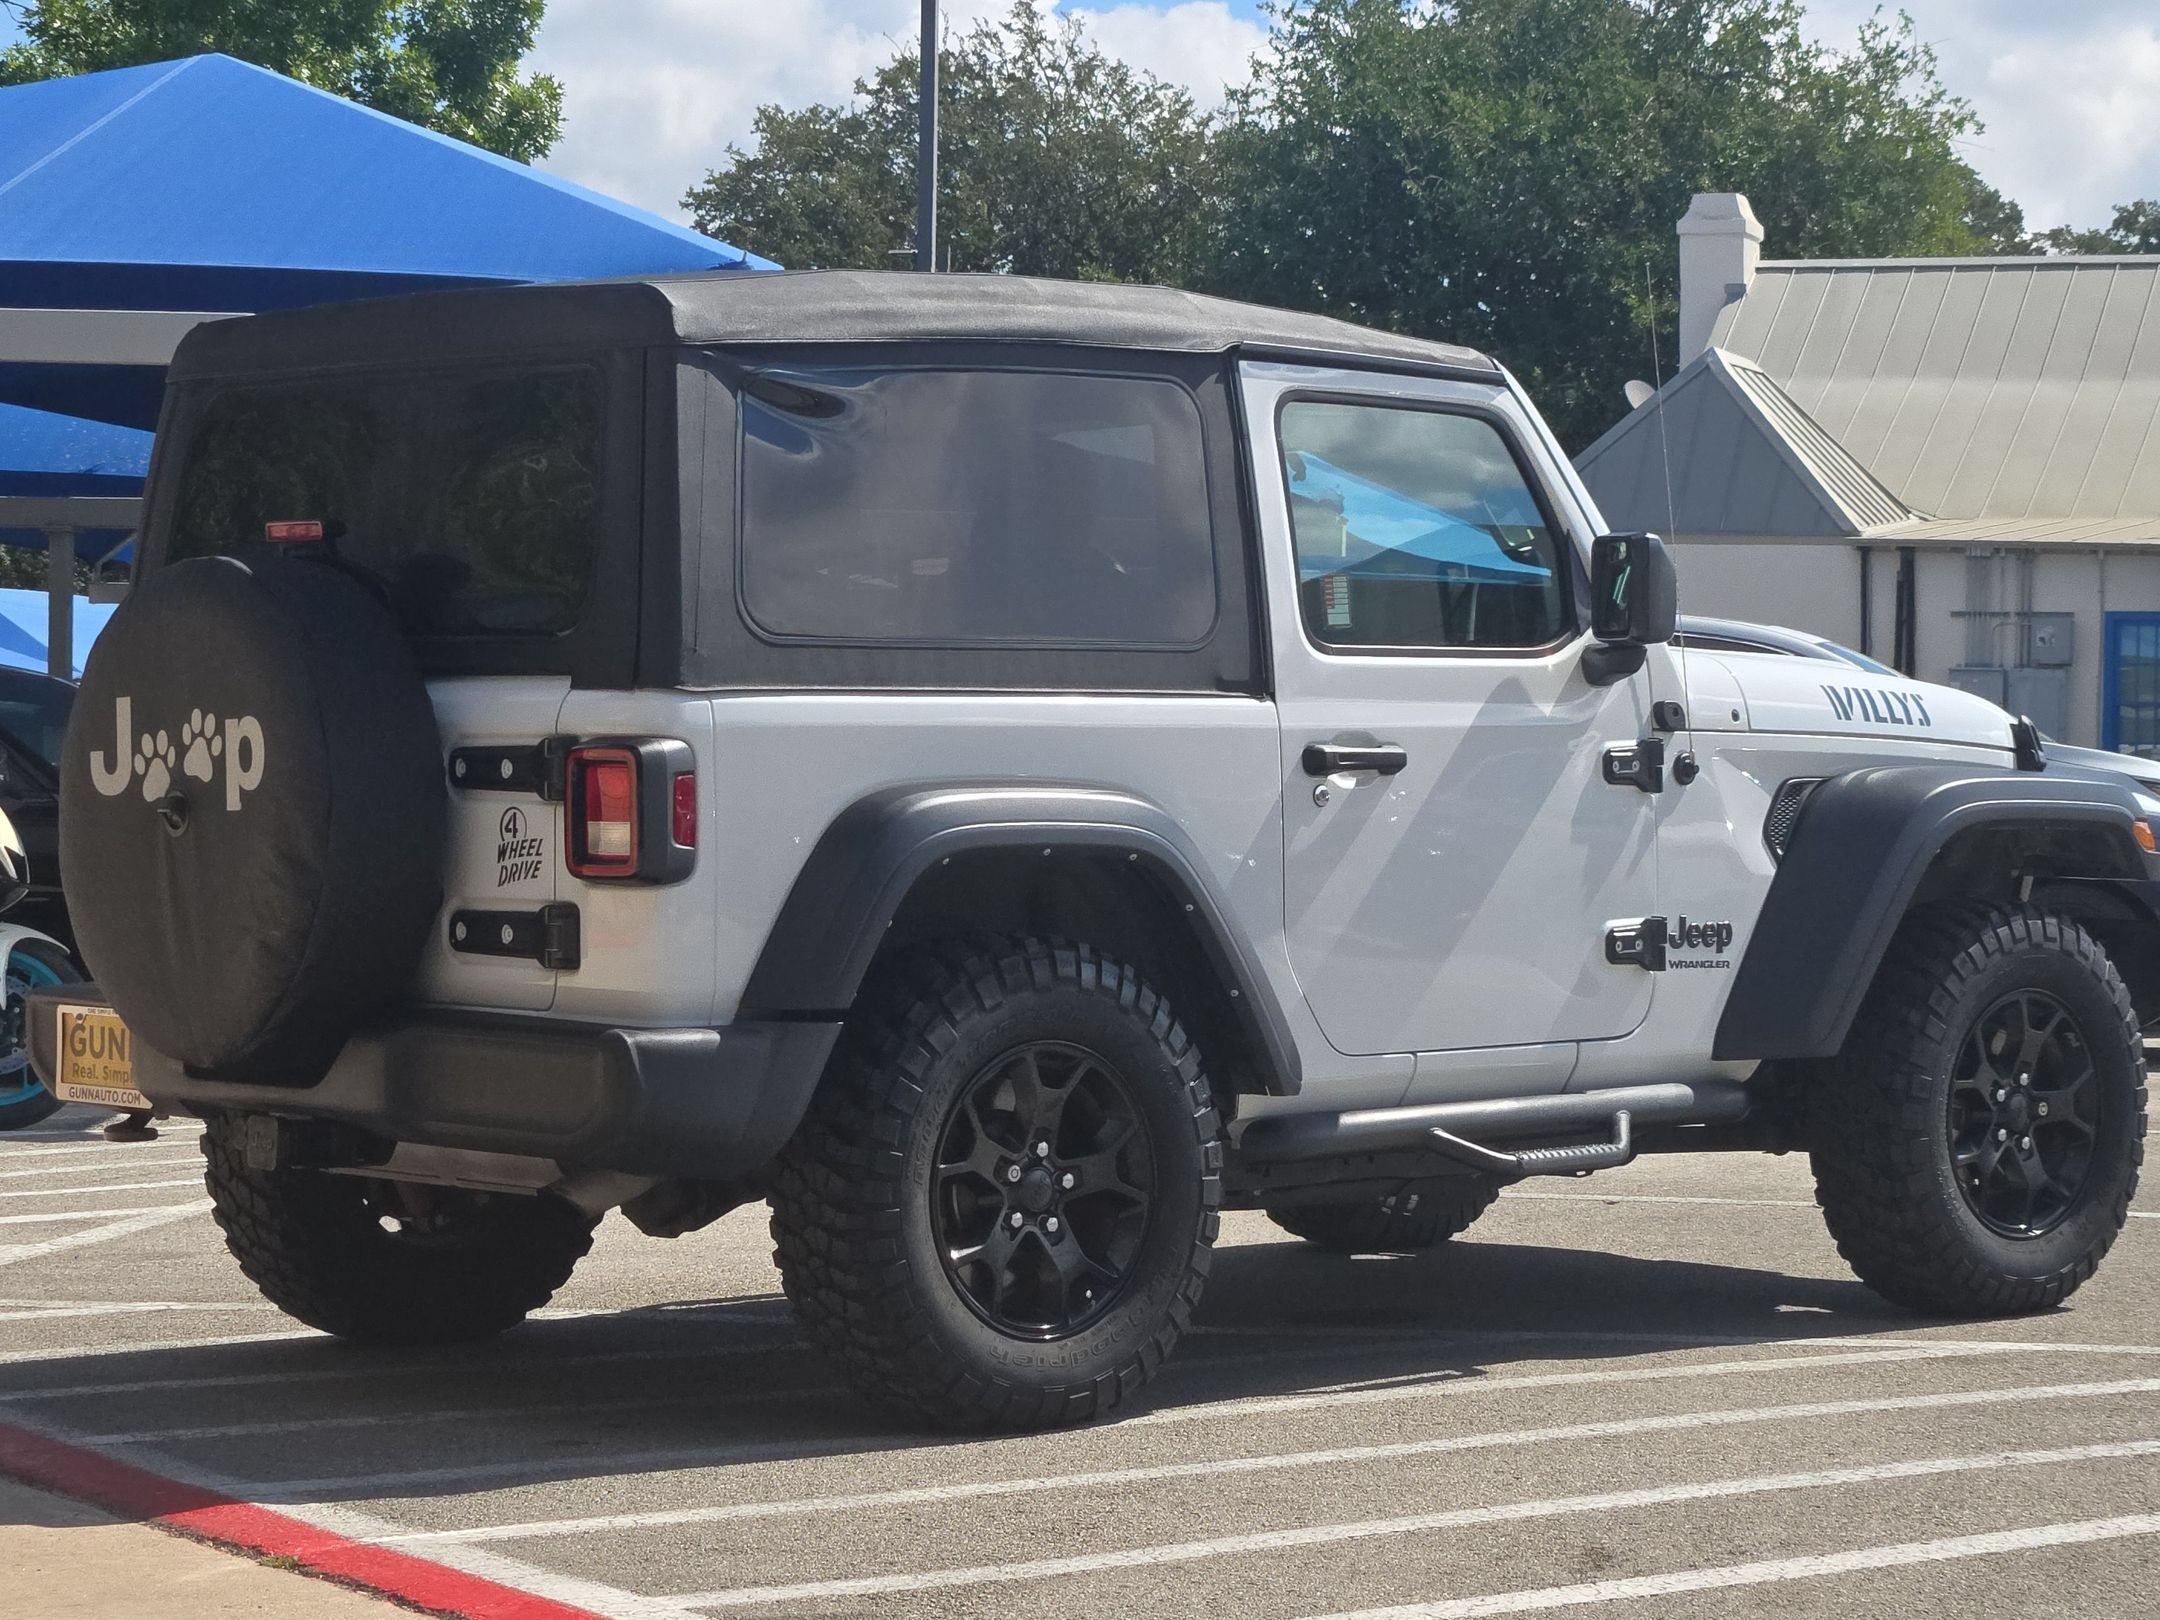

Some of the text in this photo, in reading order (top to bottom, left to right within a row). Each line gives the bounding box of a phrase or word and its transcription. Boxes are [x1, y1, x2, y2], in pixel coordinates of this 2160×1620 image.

[1820, 685, 1931, 727] WILLYS
[497, 838, 544, 864] WHEEL
[497, 860, 542, 888] DRIVE
[1668, 914, 1733, 954] Jeep
[1668, 959, 1731, 969] WRANGLER
[72, 1063, 98, 1080] Real.
[69, 1087, 141, 1105] GUNNAUTO.COM
